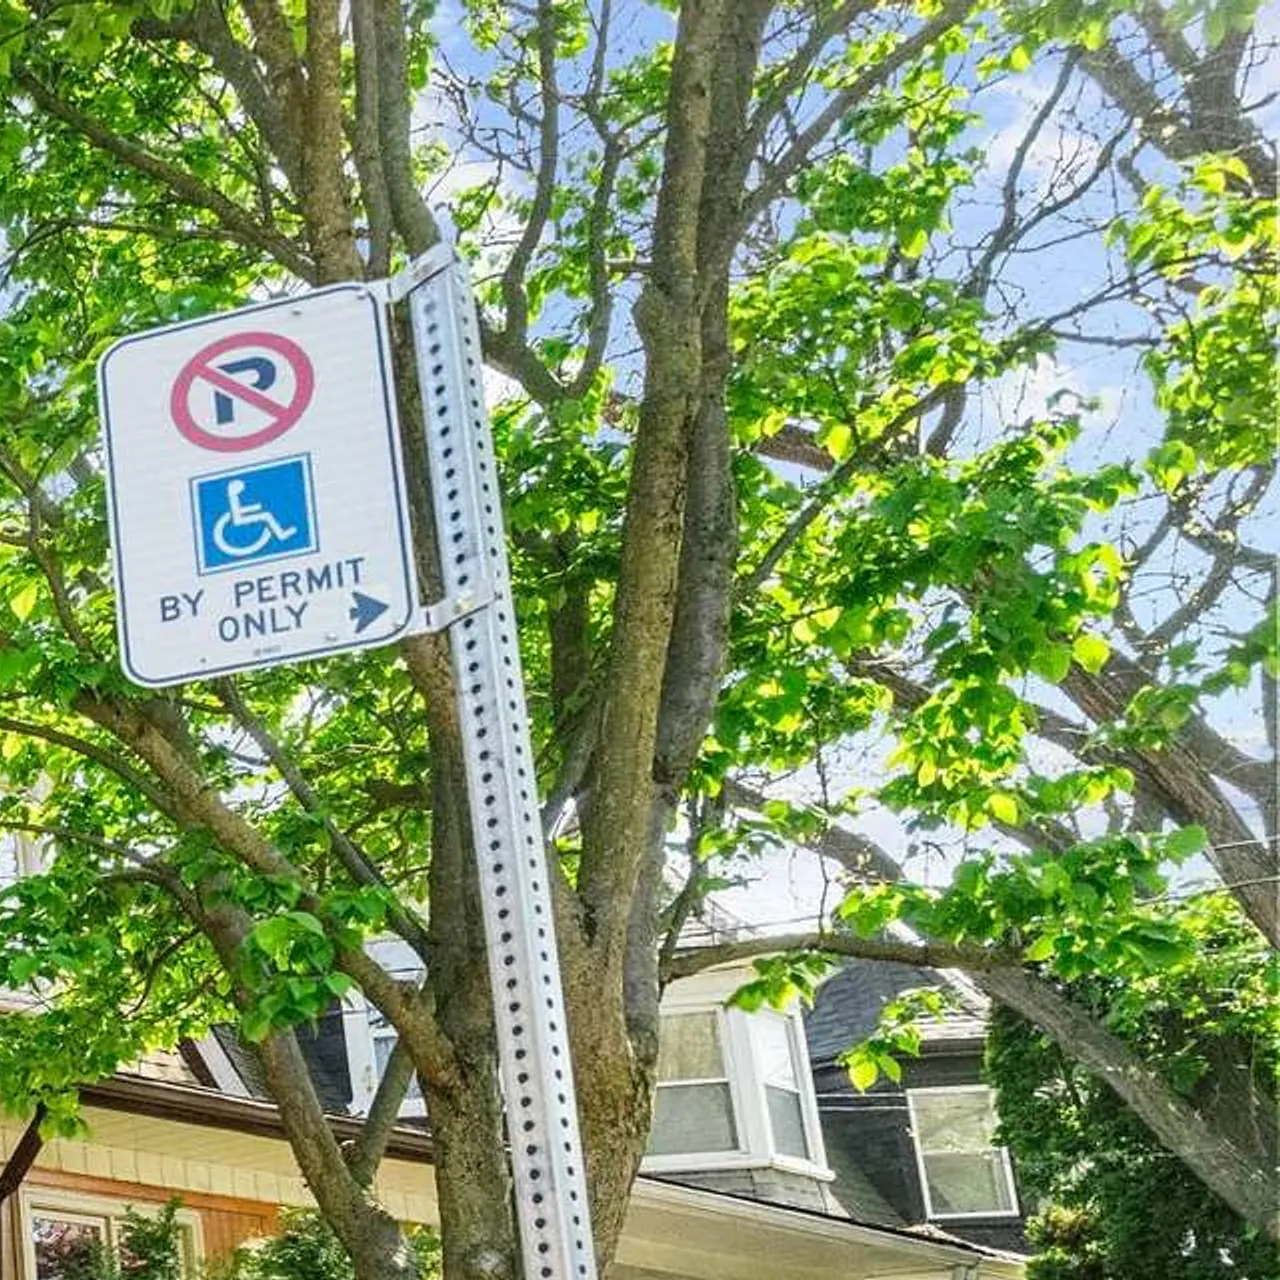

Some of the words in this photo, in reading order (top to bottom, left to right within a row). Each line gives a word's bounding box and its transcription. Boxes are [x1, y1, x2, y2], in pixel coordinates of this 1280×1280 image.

[214, 355, 277, 426] P
[160, 589, 204, 622] BY
[234, 557, 365, 608] PERMIT
[218, 602, 308, 642] ONLY
